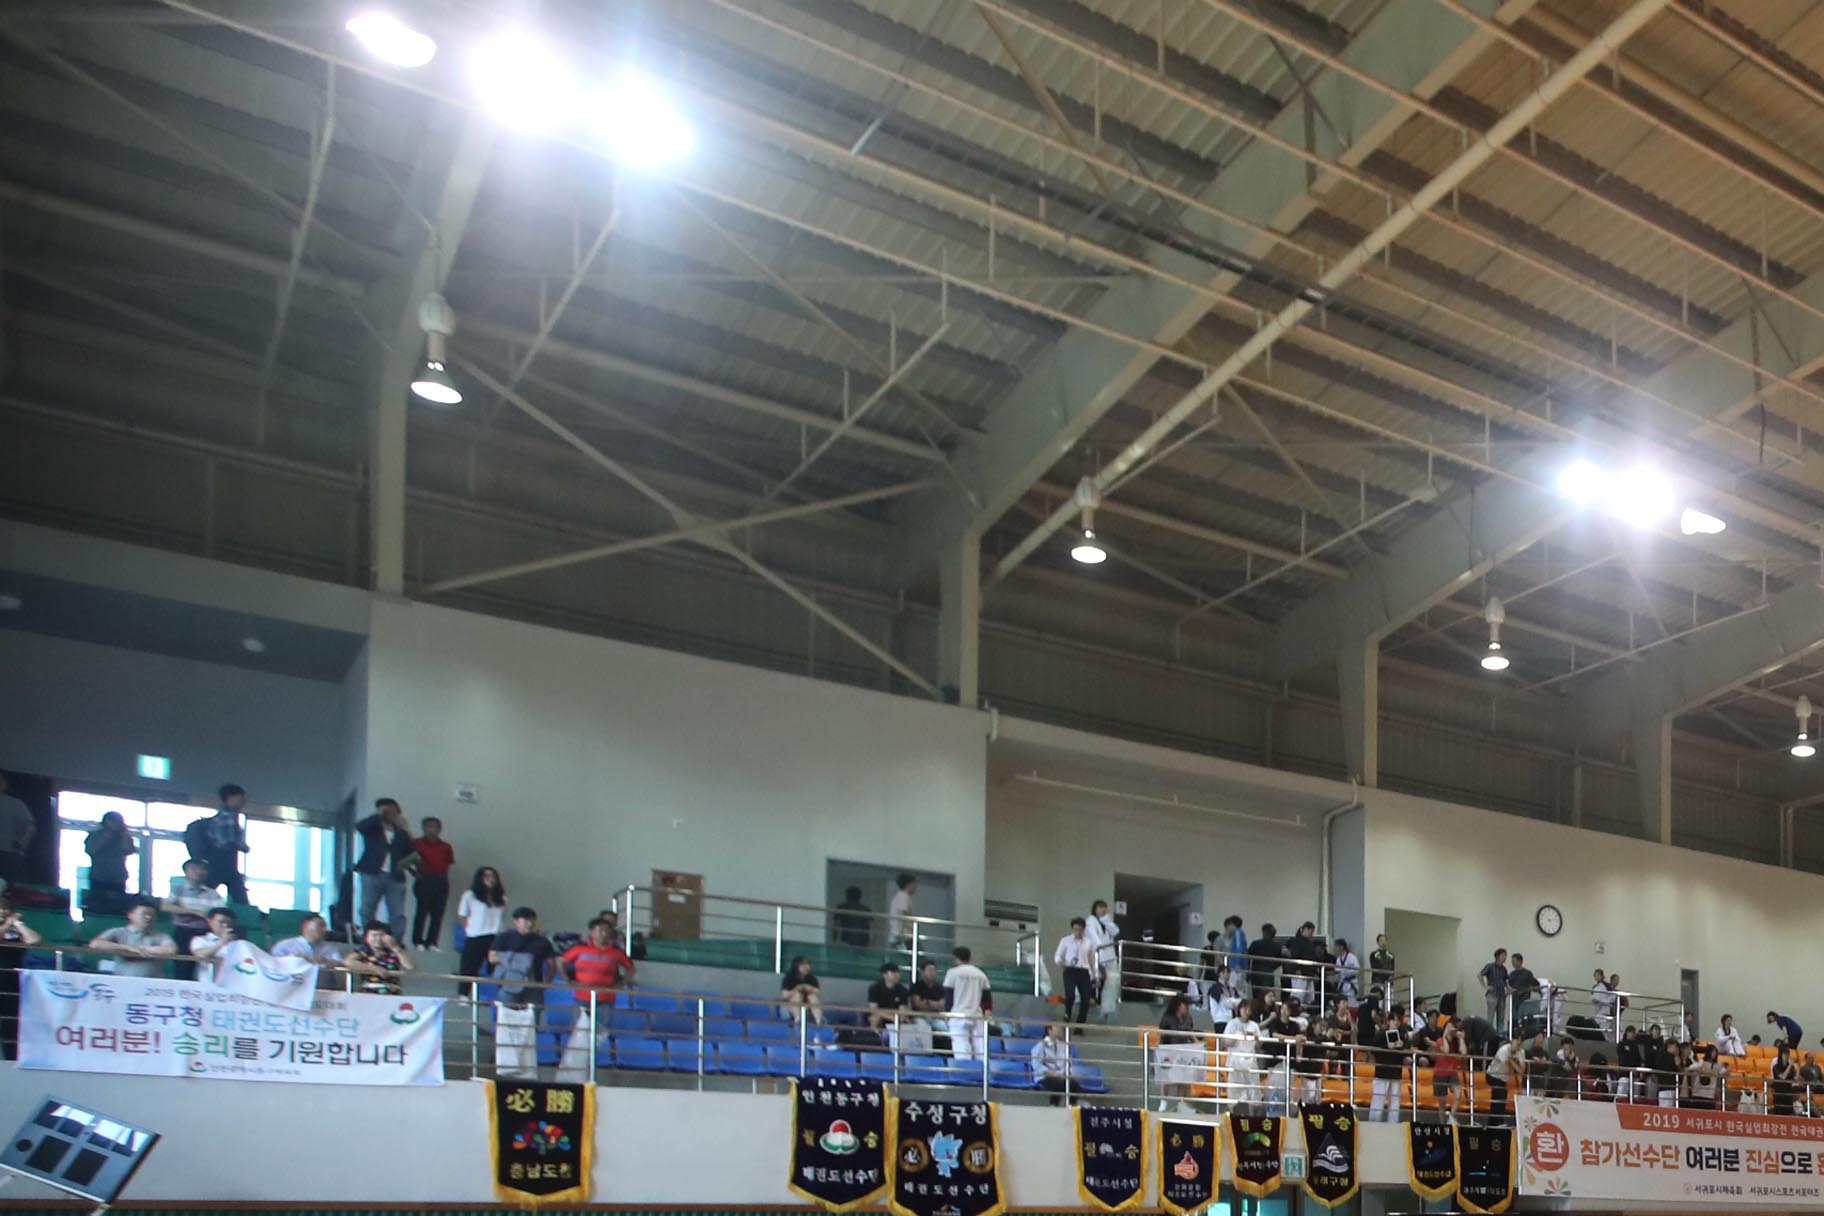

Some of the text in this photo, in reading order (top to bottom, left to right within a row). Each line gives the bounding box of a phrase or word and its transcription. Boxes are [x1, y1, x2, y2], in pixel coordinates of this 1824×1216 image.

[126, 1003, 359, 1038] 동구청 태권도선수단
[56, 1025, 409, 1066] 여러분! 승리를 기원합니다
[904, 1101, 987, 1125] 수성구청
[1643, 1112, 1680, 1129] 2019
[1686, 1117, 1722, 1130] 서귀포시
[1535, 1131, 1564, 1165] 환
[1580, 1138, 1680, 1170] 참가선수단
[1685, 1146, 1740, 1172] 여러분
[1745, 1149, 1813, 1175] 진심으로
